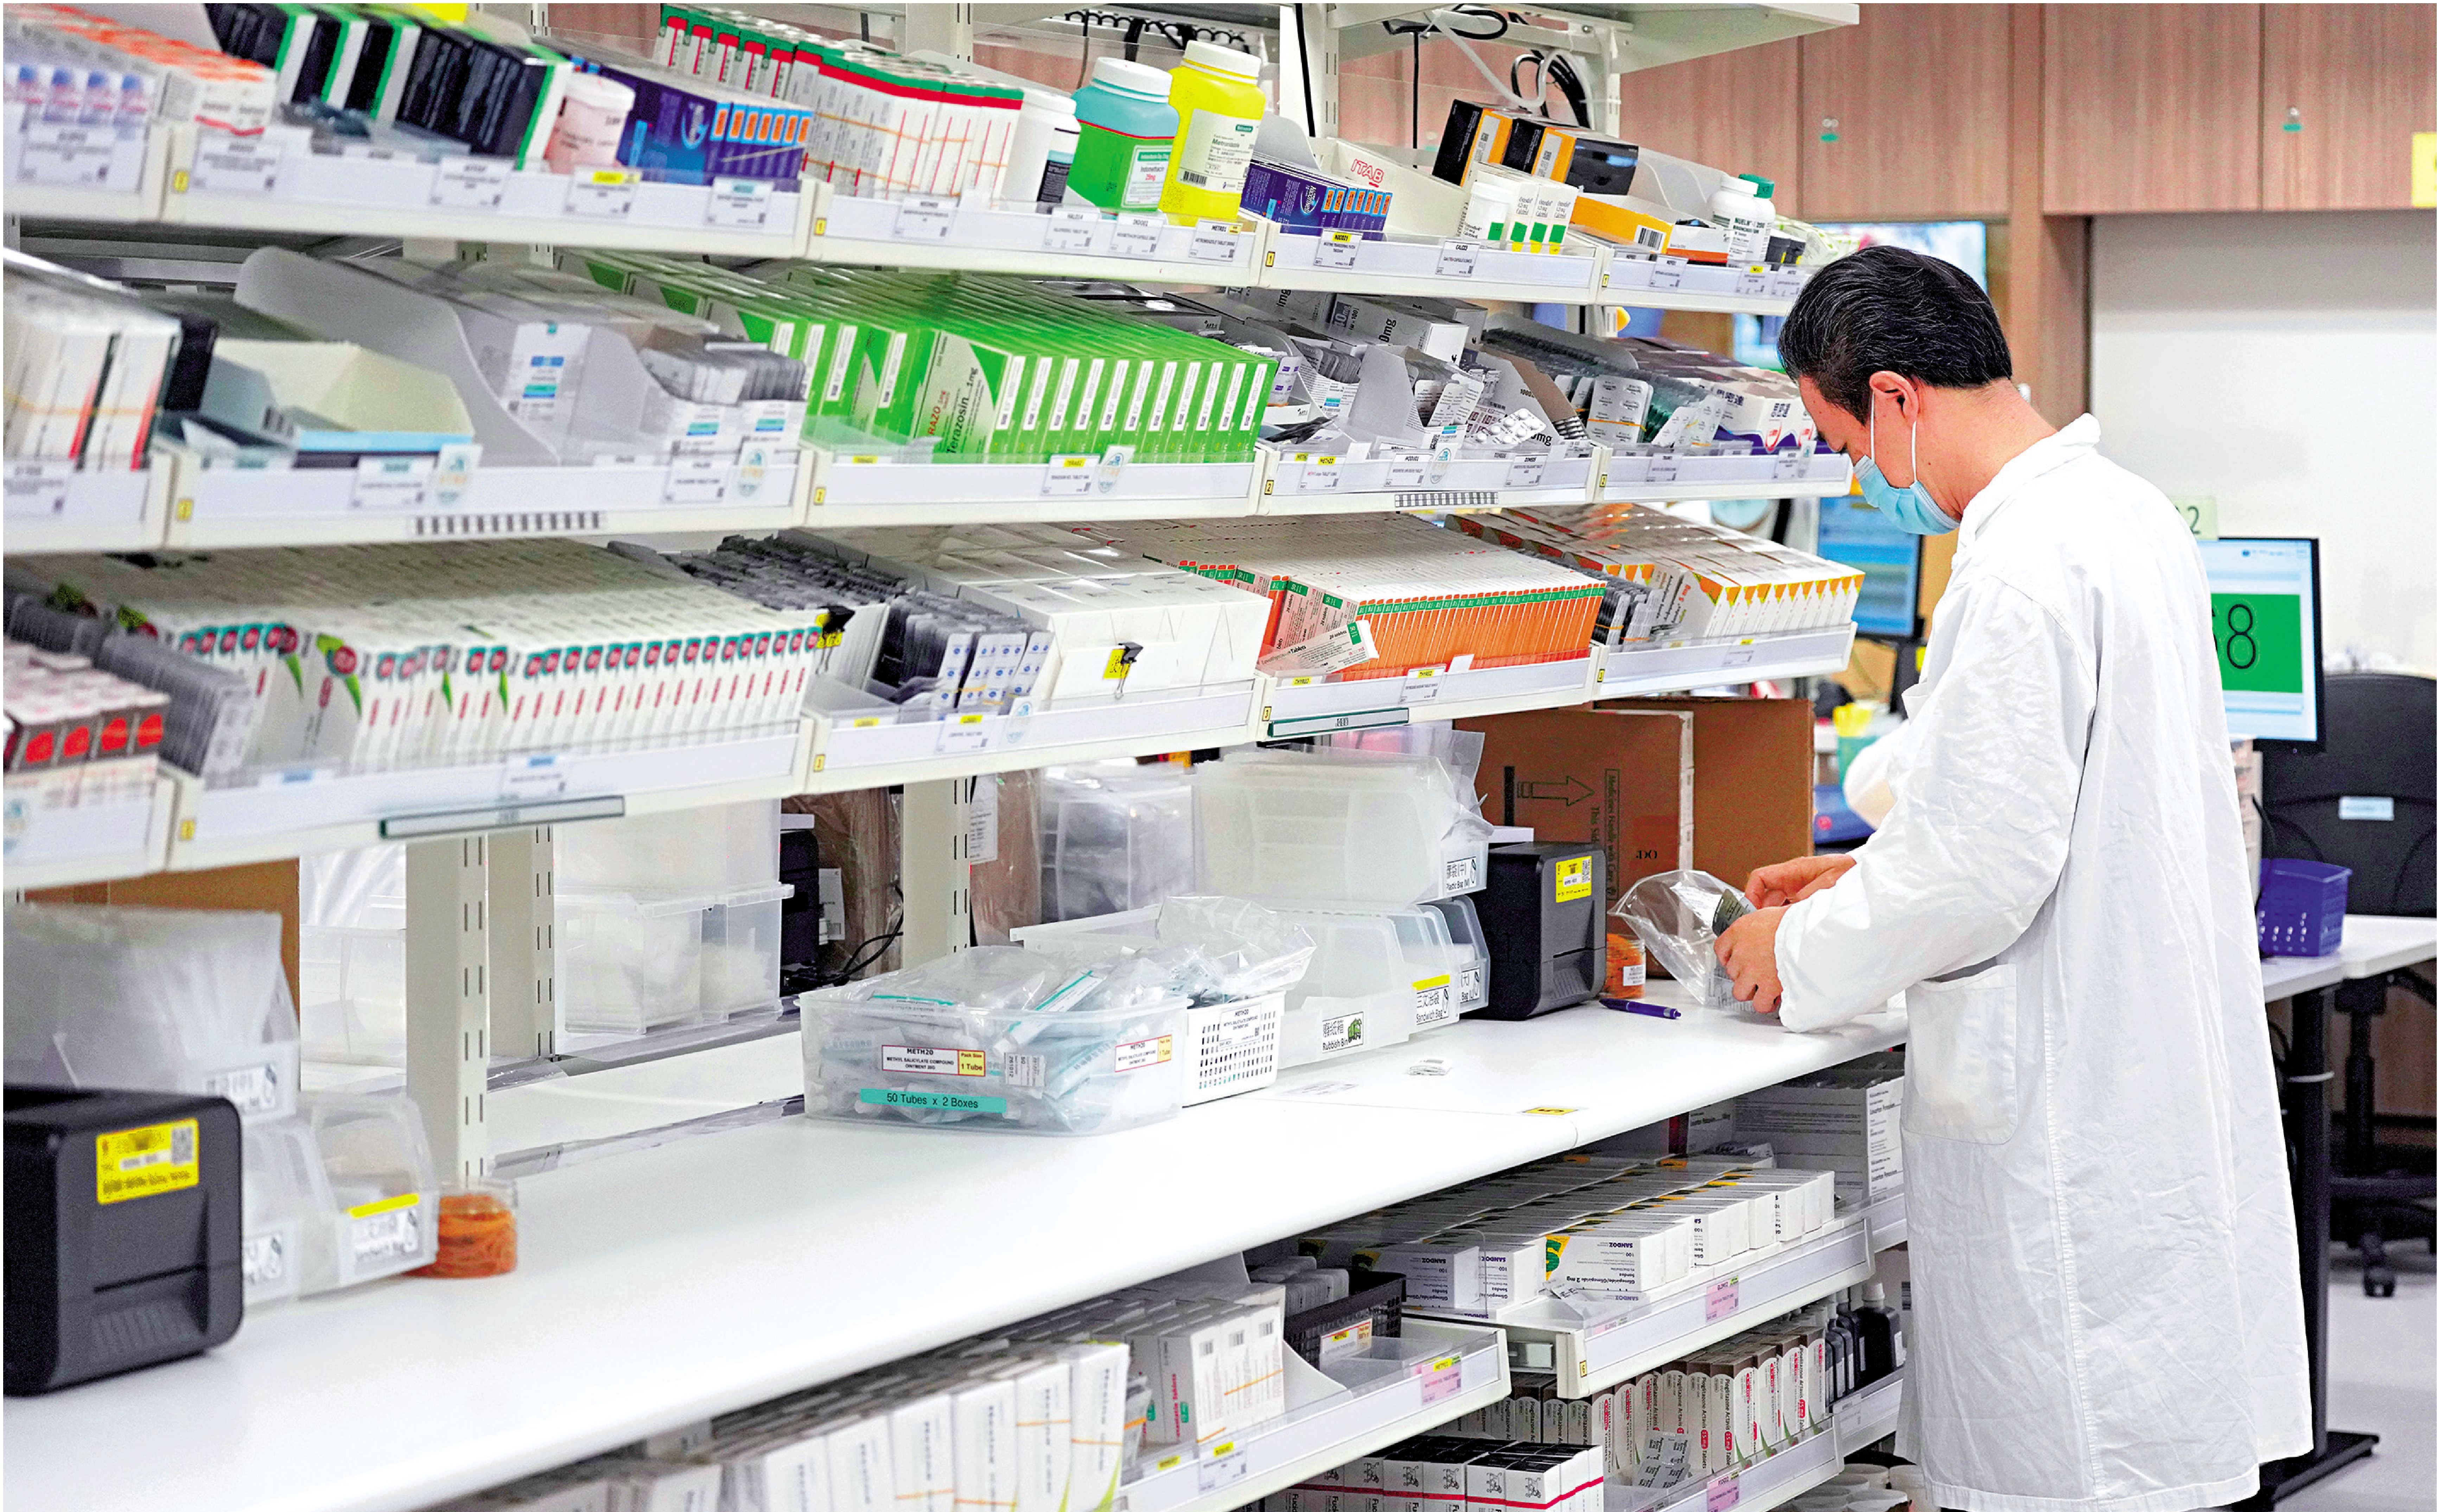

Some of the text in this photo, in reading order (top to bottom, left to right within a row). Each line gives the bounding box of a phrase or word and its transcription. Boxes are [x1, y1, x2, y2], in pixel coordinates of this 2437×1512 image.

[1351, 159, 1385, 183] ITAB
[1591, 828, 1600, 842] Sid
[1416, 1010, 1434, 1023] Sandwich
[1323, 1039, 1340, 1051] Rubbish
[887, 1093, 898, 1102] 50
[901, 1094, 927, 1105] Tubes
[942, 1098, 948, 1106] 2
[951, 1098, 979, 1109] Boxes
